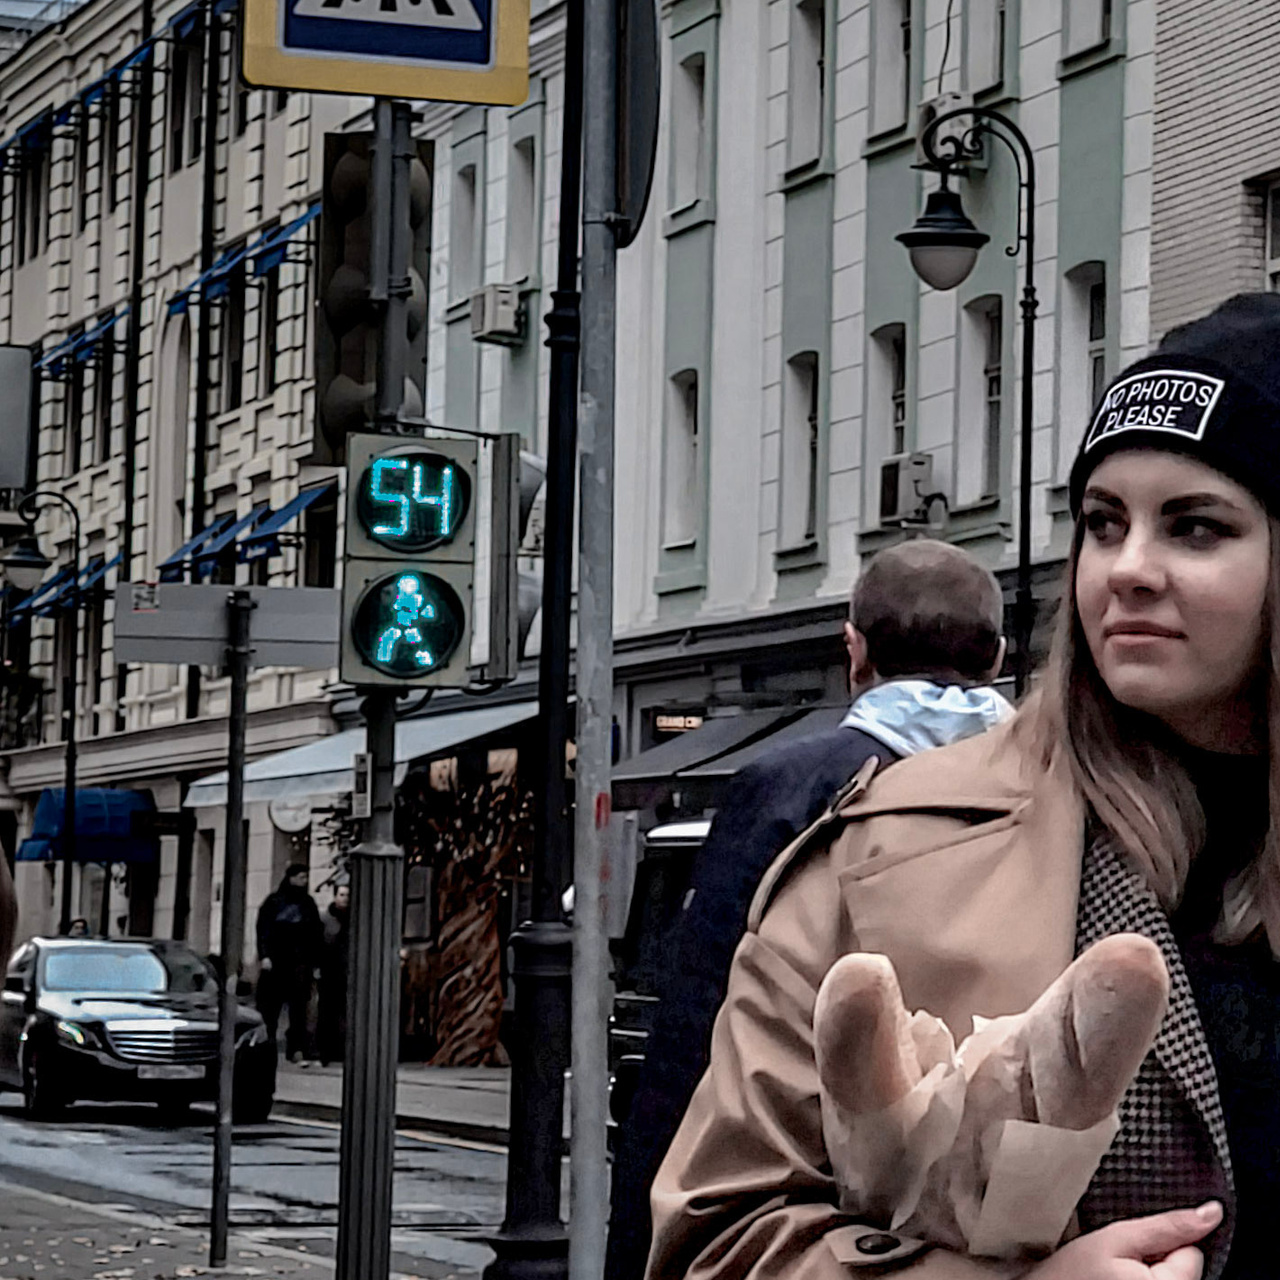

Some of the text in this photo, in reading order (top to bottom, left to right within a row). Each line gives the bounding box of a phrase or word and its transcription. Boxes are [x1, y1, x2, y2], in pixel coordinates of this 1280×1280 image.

[1105, 379, 1213, 411] NO PHOTOS
[1103, 404, 1182, 433] PLEASE
[371, 458, 452, 536] 54
